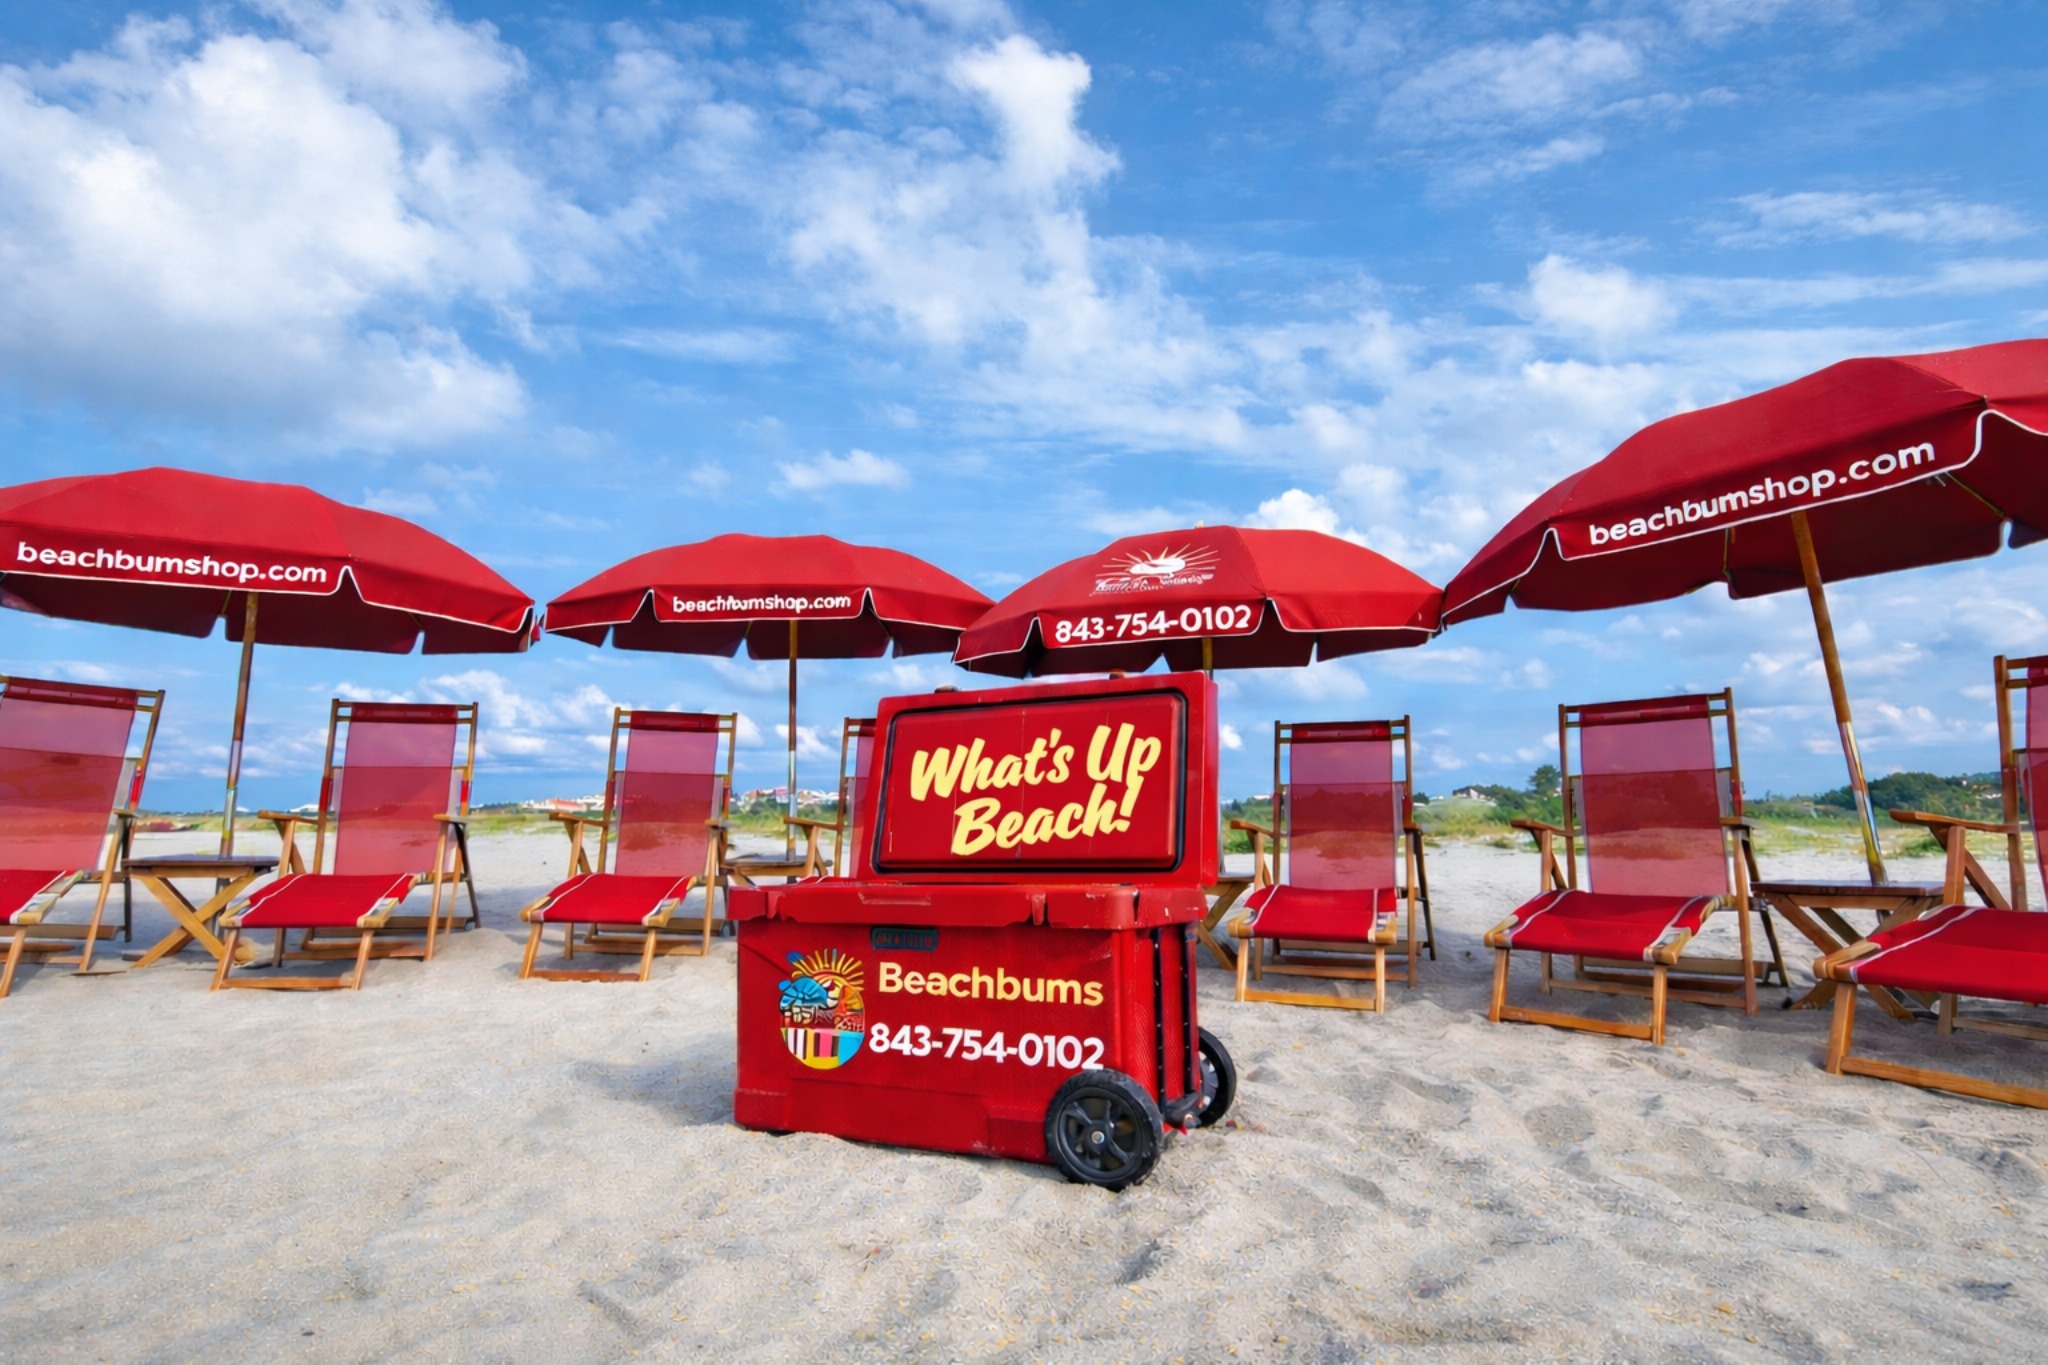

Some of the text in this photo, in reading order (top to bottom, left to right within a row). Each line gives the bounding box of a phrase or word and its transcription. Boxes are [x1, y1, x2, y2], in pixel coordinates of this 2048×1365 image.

[1589, 442, 1936, 545] beachbumshop.com
[16, 541, 327, 584] beachbumshop.com
[672, 594, 852, 614] beachbumshop.com
[1055, 604, 1252, 643] 843-754-0102
[910, 722, 1162, 801] What's Up
[951, 776, 1144, 856] Beach!
[879, 961, 1104, 1007] Beachbums
[868, 1022, 1105, 1070] 843-754-0102
